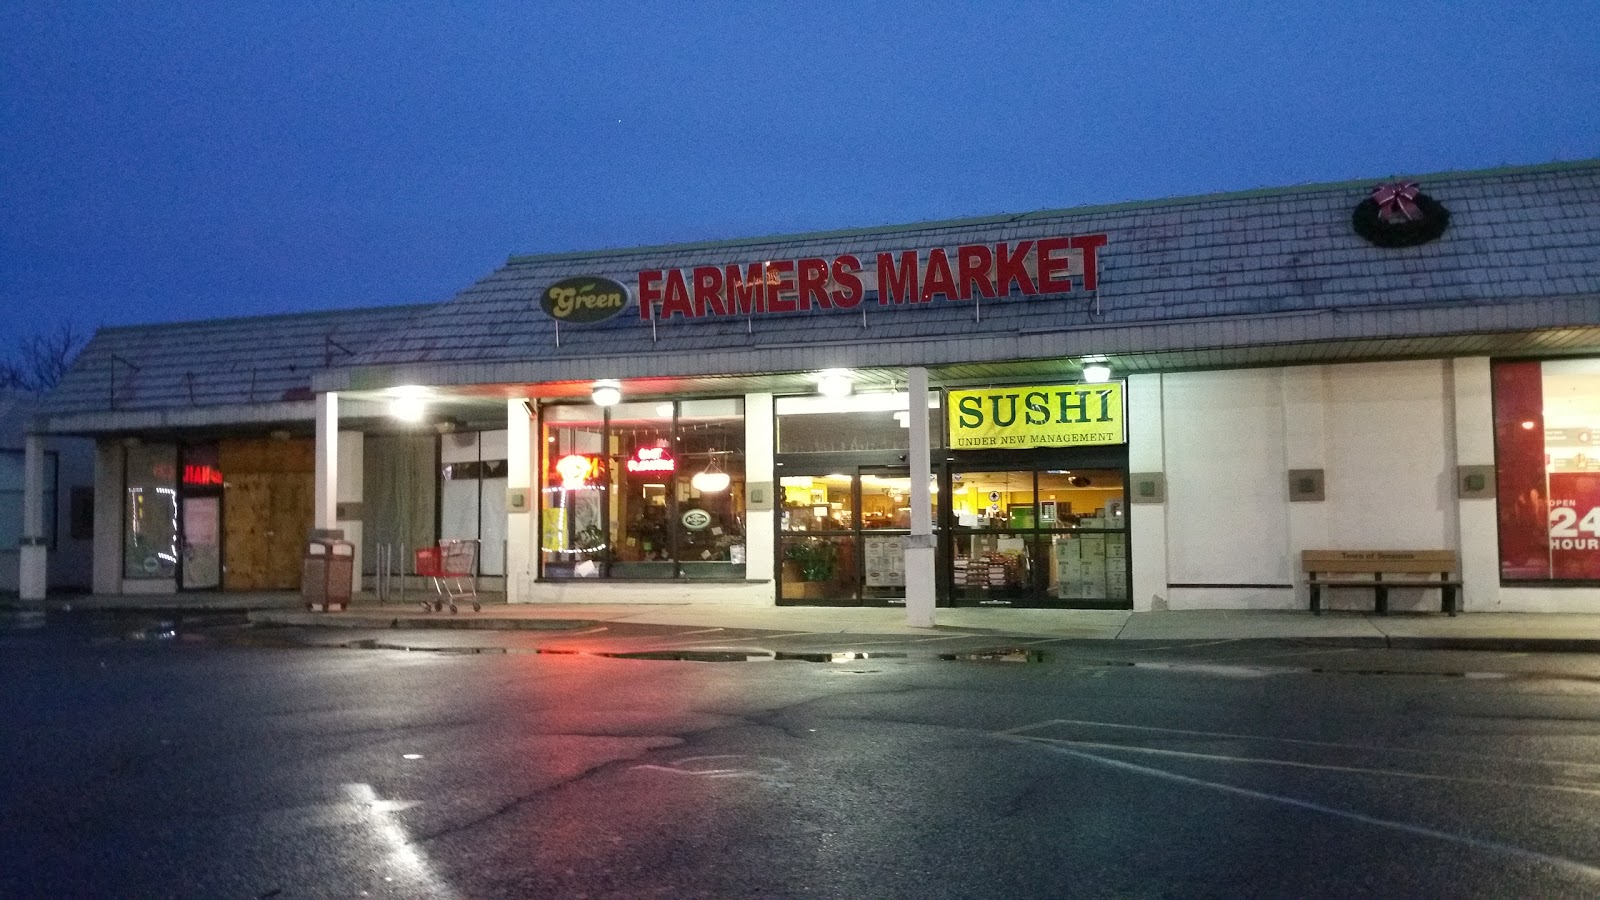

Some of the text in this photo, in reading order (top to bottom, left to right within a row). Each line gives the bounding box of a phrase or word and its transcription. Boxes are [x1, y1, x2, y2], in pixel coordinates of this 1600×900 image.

[638, 234, 1108, 321] FARMERS MARKET
[550, 285, 622, 317] Green
[958, 389, 1114, 429] SUSHI
[957, 432, 1114, 447] UNDER NEW MANAGEMENT
[1549, 499, 1576, 507] OPEN
[1548, 506, 1600, 538] 24
[1341, 552, 1364, 560] Town
[1366, 552, 1375, 560] of
